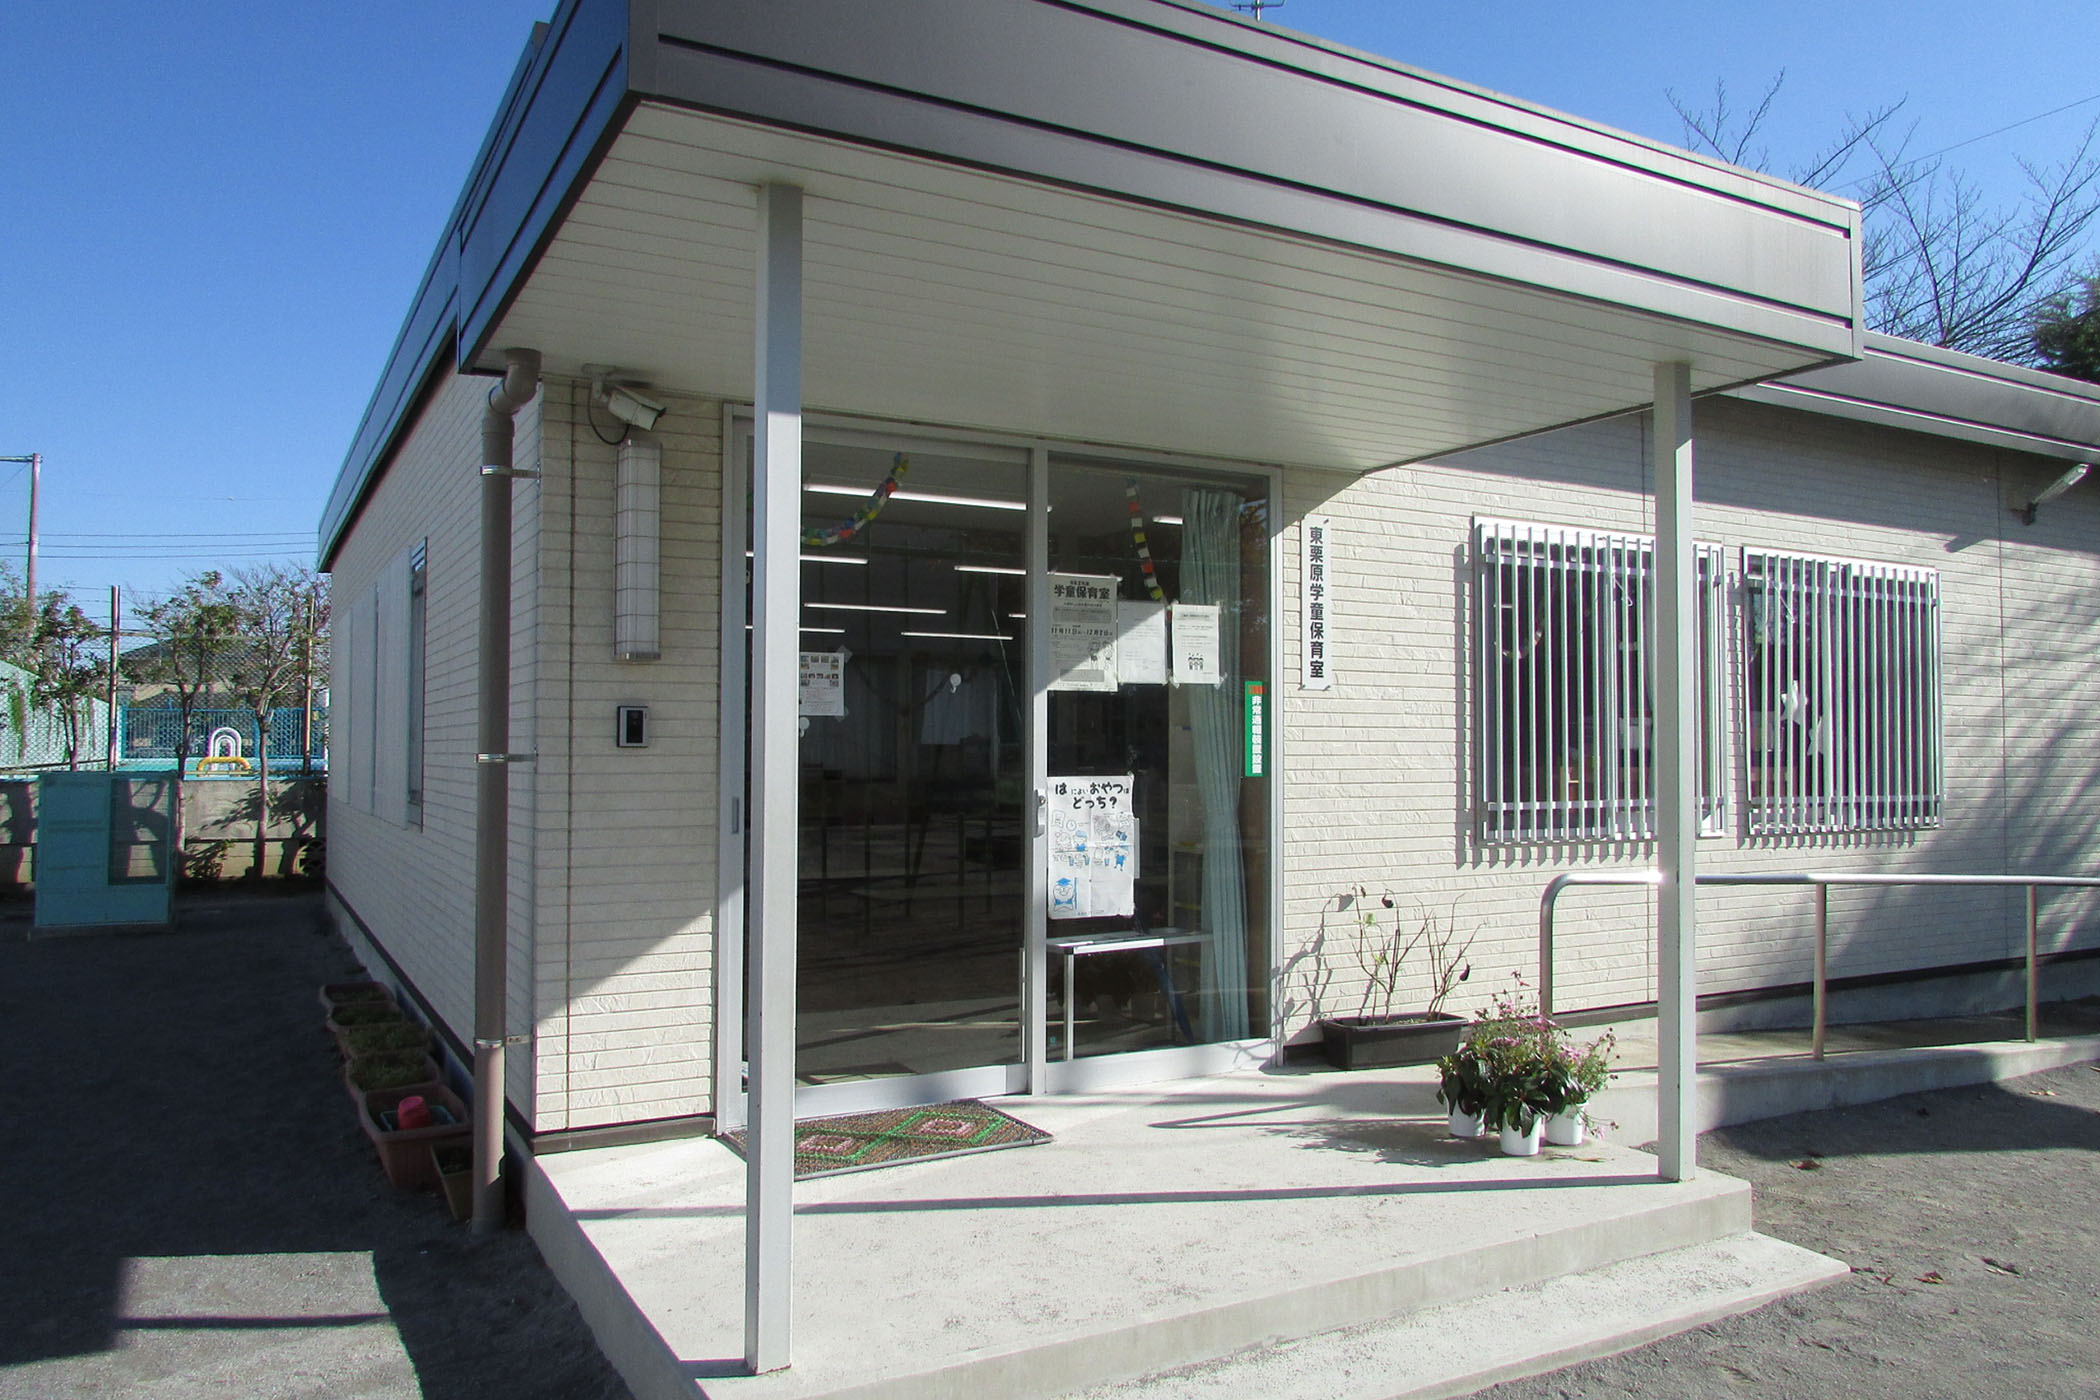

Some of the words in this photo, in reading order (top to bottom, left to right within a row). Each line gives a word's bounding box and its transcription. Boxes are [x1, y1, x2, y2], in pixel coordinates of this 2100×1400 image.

[1053, 584, 1110, 600] 学童保育室
[1309, 526, 1324, 678] 東栗原学童保育室
